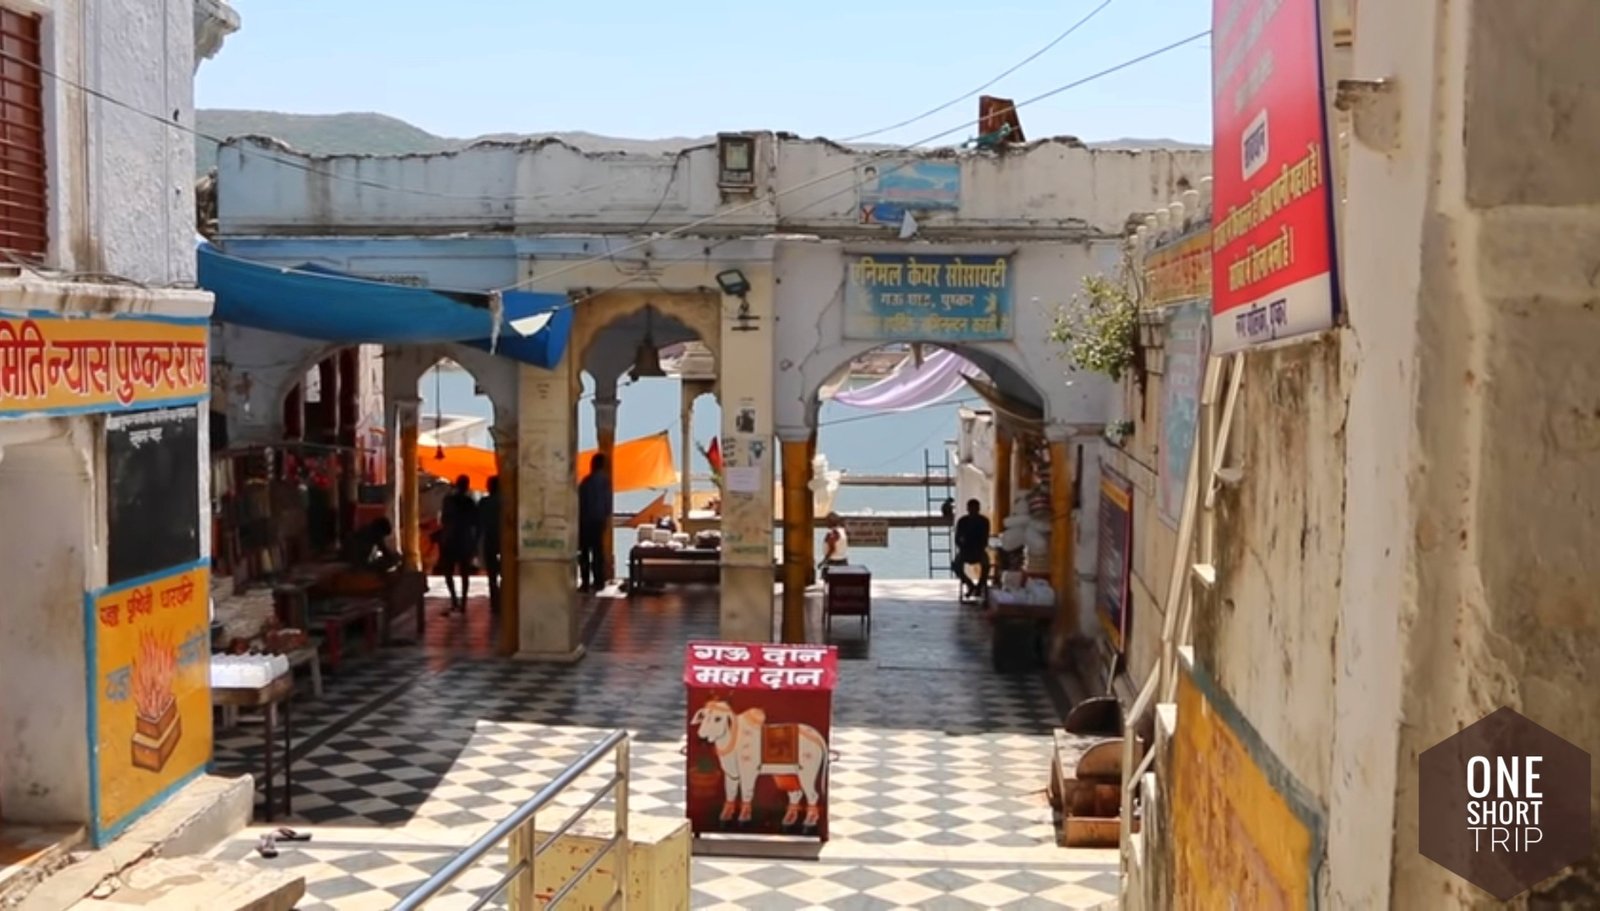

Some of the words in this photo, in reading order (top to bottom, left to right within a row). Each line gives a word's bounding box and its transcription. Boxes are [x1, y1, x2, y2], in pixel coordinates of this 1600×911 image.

[907, 257, 940, 288] केयर
[49, 340, 112, 394] न्यास
[693, 645, 751, 661] गऊ
[761, 647, 828, 666] दान
[692, 665, 754, 686] महा
[759, 668, 824, 689] दान
